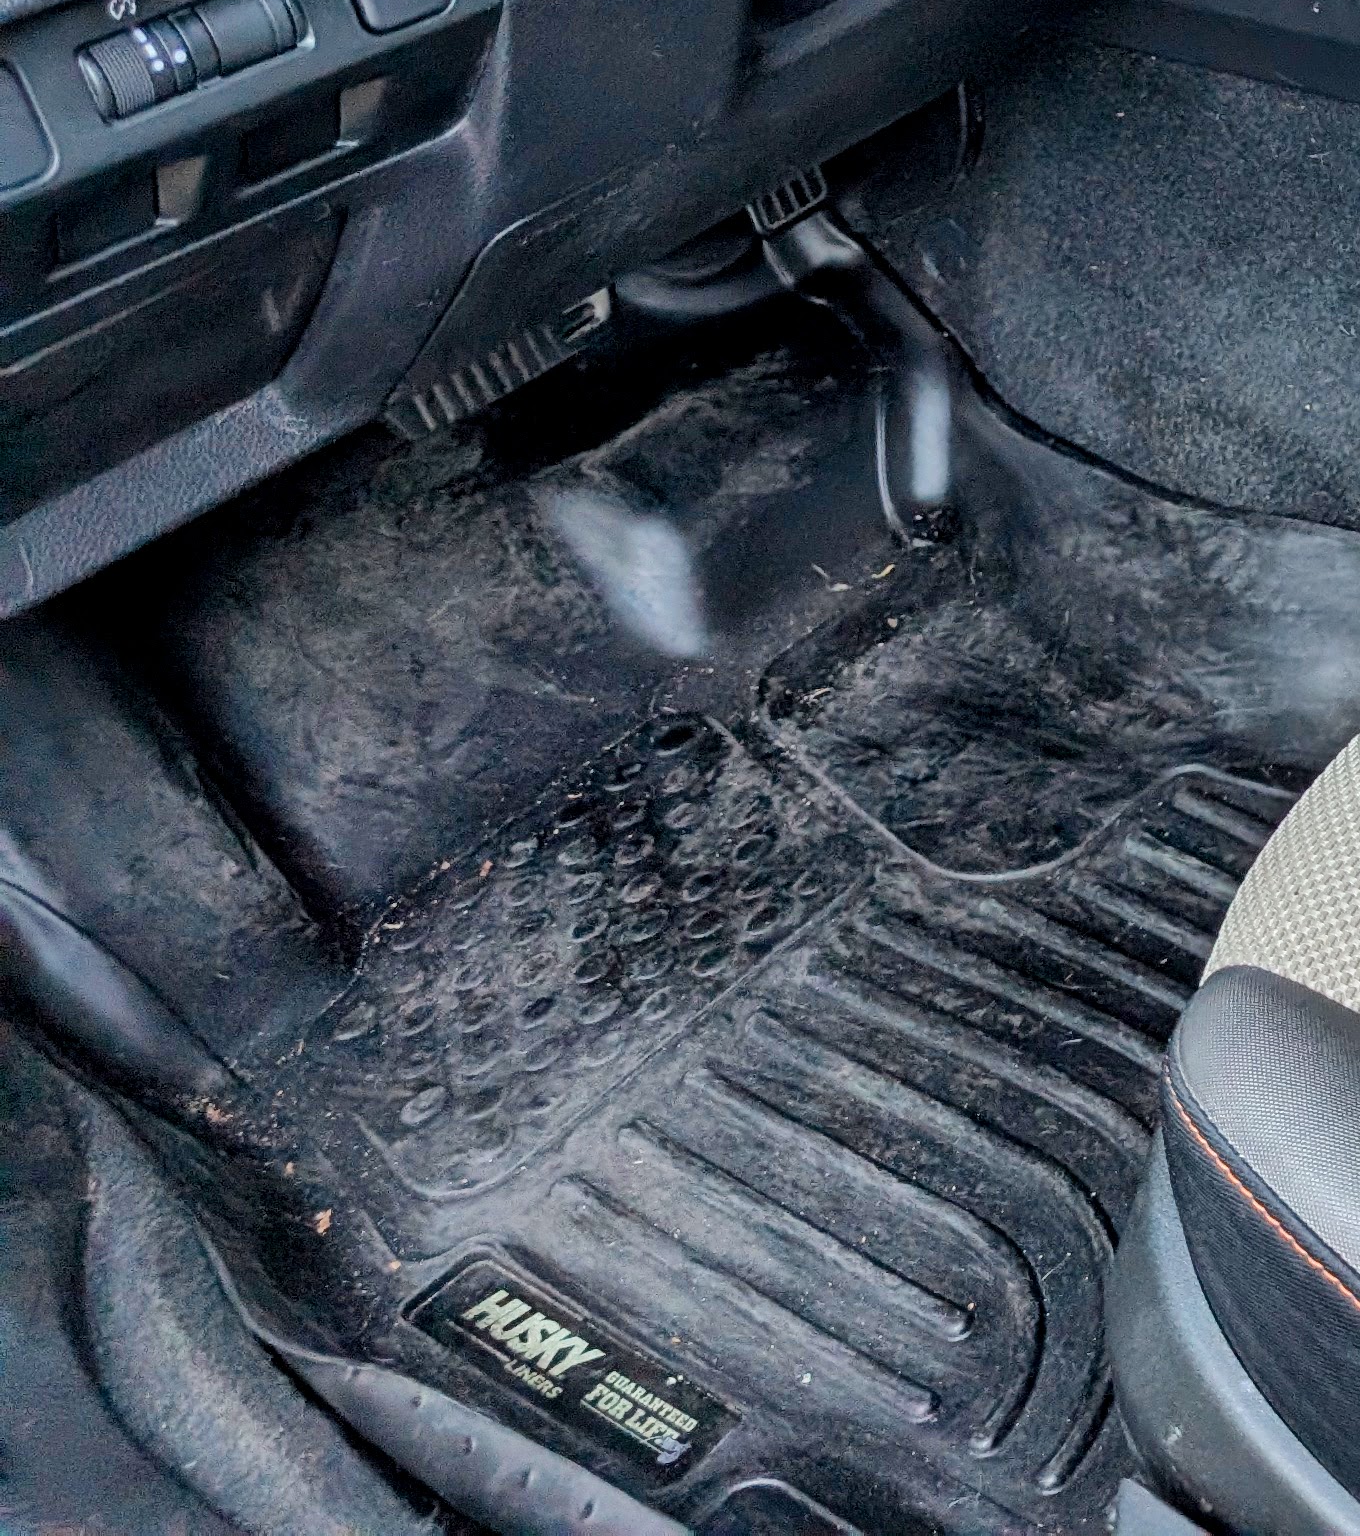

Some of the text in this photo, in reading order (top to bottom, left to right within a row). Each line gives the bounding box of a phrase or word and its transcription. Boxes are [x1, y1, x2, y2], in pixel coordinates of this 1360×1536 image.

[460, 1289, 607, 1378] HUSKY
[503, 1358, 564, 1399] LINERS
[584, 1383, 634, 1420] FOR
[604, 1370, 699, 1432] GUARANTEED
